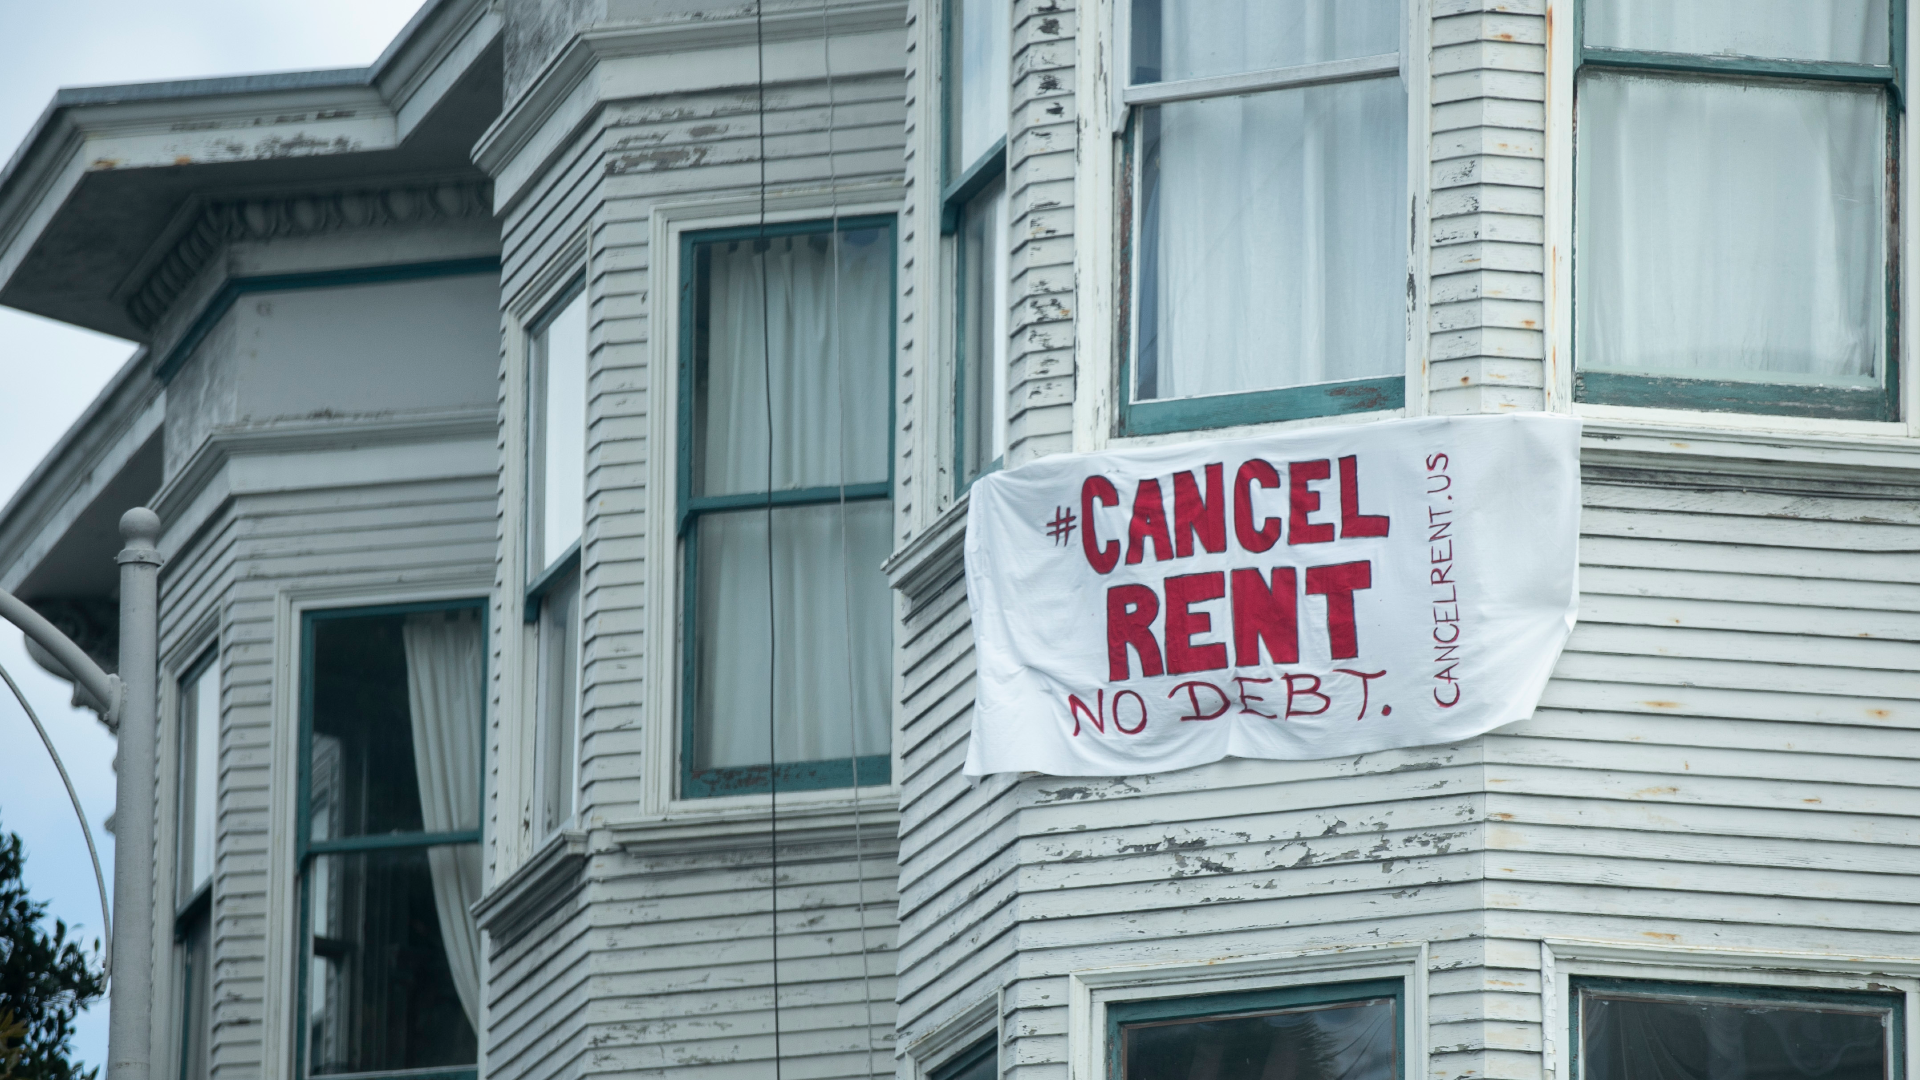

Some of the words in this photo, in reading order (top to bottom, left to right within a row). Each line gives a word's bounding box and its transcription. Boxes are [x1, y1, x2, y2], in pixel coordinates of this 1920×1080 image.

[1046, 453, 1391, 575] #CANCEL
[1106, 560, 1372, 683] RENT
[1425, 451, 1462, 709] CANCELRENT.US
[1068, 688, 1148, 737] NO
[1167, 669, 1393, 722] DEBT.
